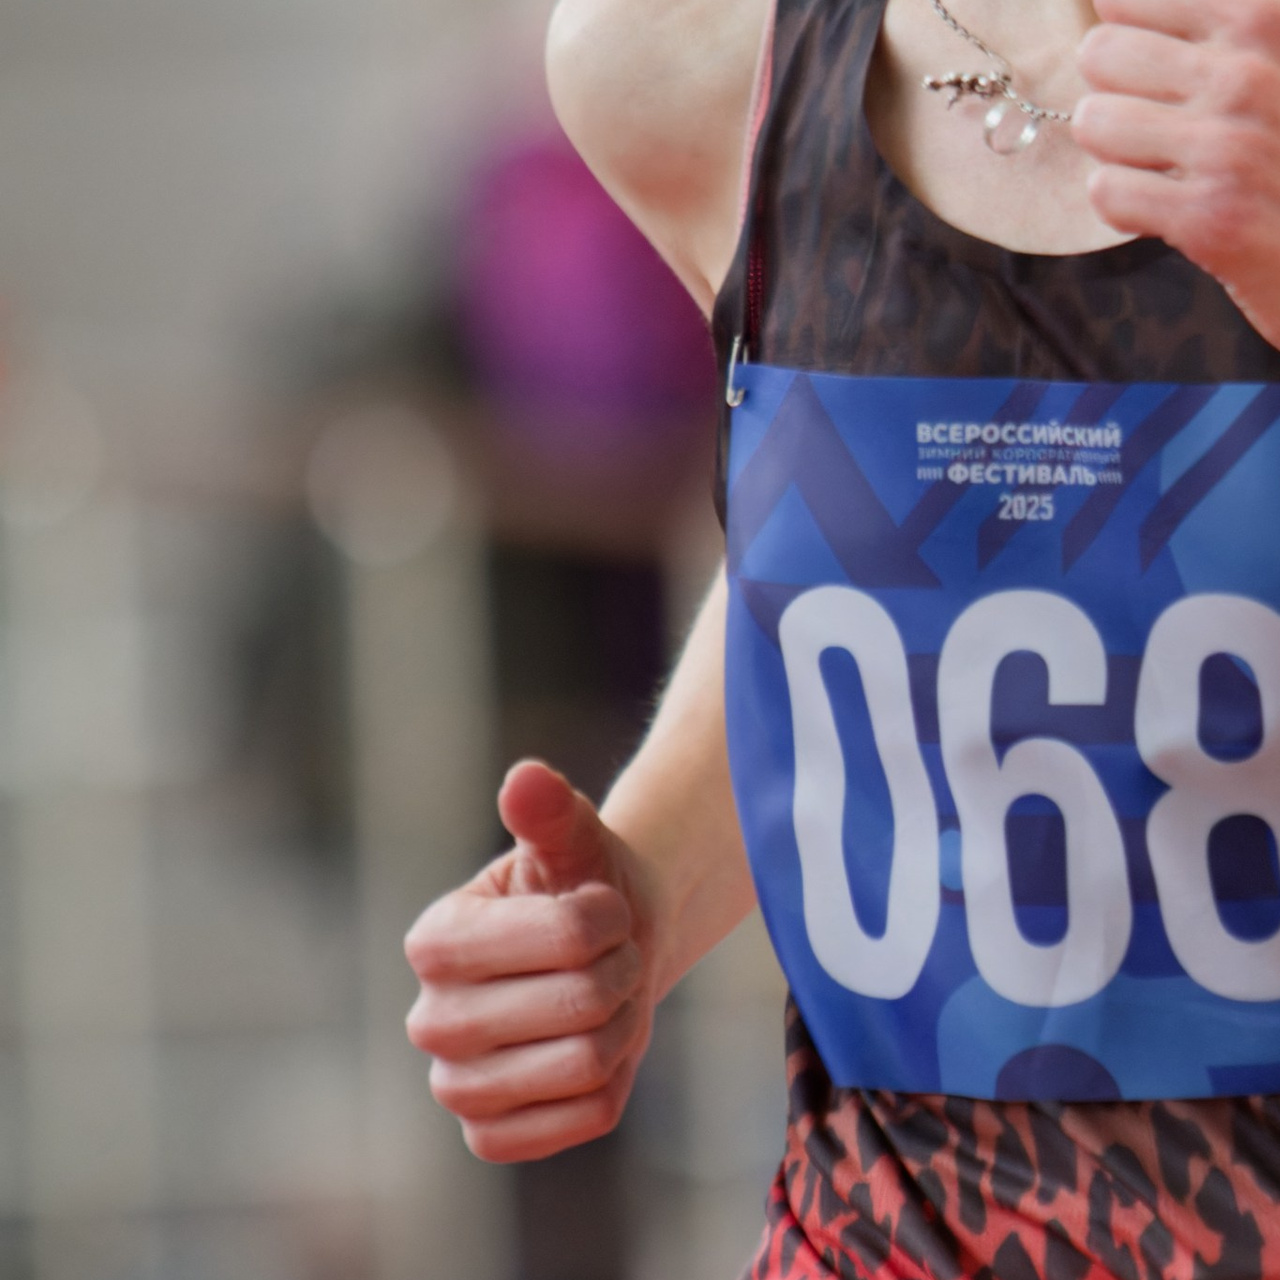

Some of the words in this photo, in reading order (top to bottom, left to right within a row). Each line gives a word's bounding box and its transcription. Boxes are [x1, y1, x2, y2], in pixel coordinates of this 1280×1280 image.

[917, 421, 1121, 448] ВСЕРОССИЙСКИЙ
[947, 463, 1097, 486] ФЕСТИВАЛЬ
[998, 493, 1054, 520] 2025
